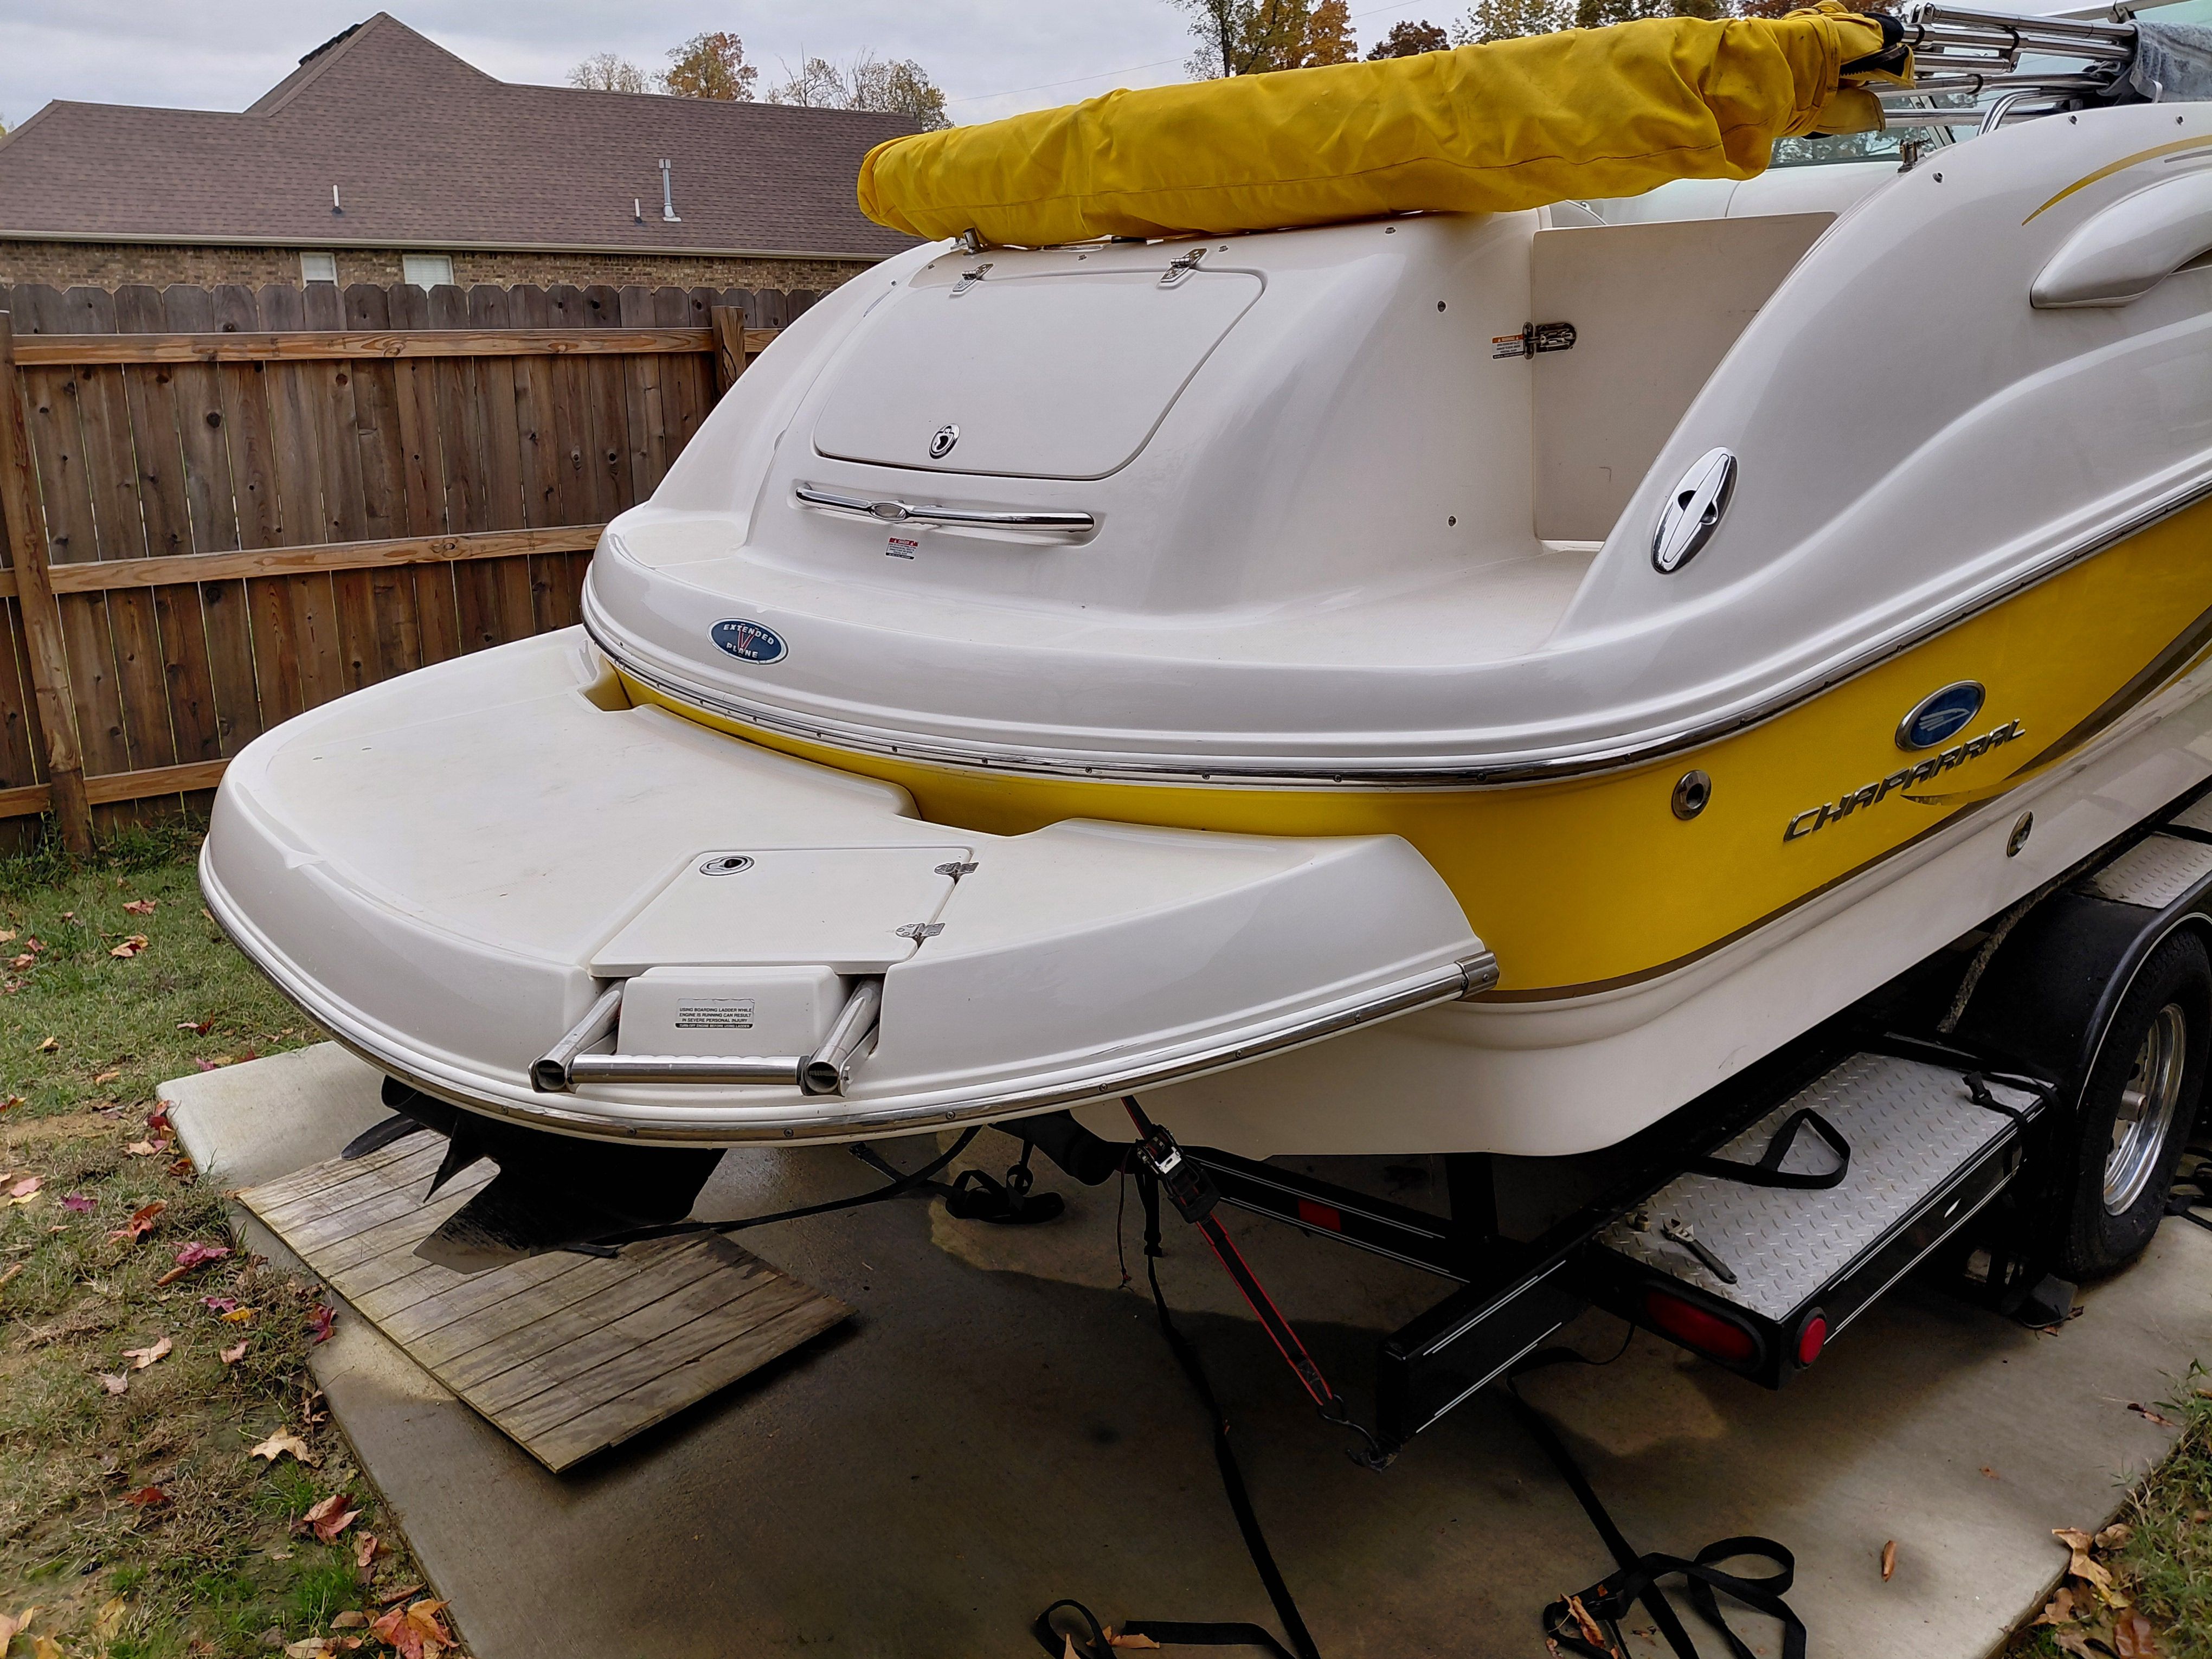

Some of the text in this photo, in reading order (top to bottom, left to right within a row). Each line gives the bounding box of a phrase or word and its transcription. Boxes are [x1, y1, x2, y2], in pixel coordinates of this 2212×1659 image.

[723, 623, 774, 645] EXTENDED
[726, 642, 758, 658] PLANE
[1783, 718, 2026, 843] CHAPARRAL
